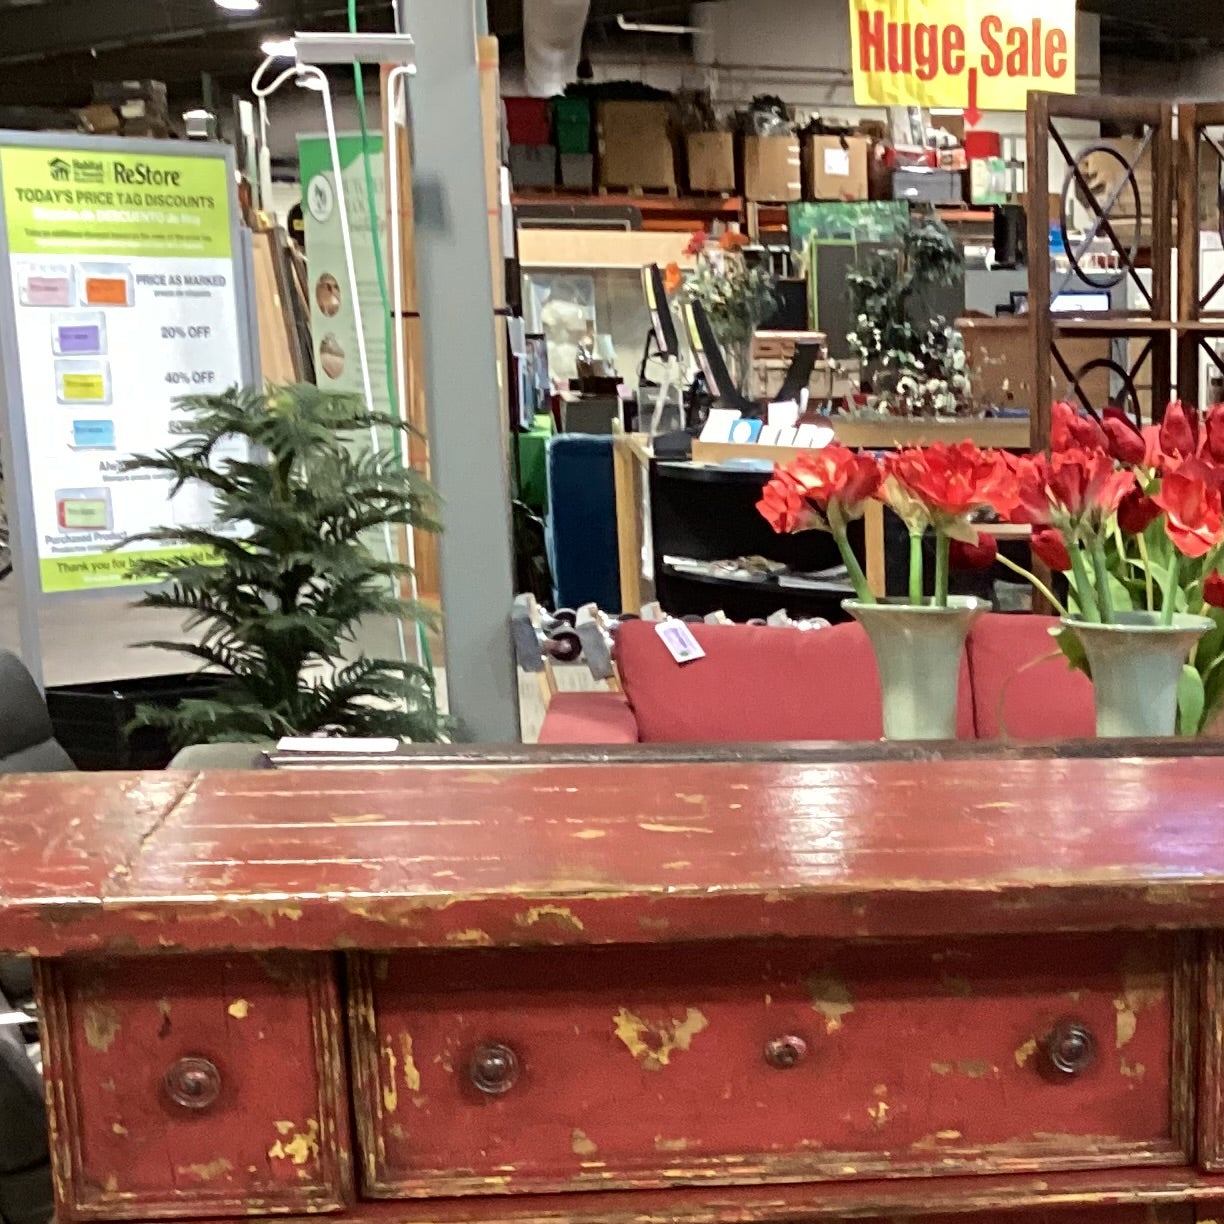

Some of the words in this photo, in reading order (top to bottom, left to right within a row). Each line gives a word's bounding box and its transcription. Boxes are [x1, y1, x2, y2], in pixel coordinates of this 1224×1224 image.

[858, 10, 965, 81] Huge
[980, 15, 1067, 78] Sale
[113, 161, 181, 186] ReStore
[15, 188, 73, 204] TODAY'S
[76, 191, 114, 205] PRICE
[116, 193, 142, 207] TAG
[145, 193, 215, 209] DISCOUNTS
[136, 274, 166, 286] PRICE
[168, 275, 183, 286] AS
[184, 275, 226, 287] MARKED
[161, 326, 186, 339] 20%
[188, 326, 211, 339] OFF
[165, 371, 190, 384] 40%
[192, 371, 216, 384] OFF
[57, 561, 89, 574] Thank
[92, 561, 110, 572] you
[112, 559, 126, 570] for
